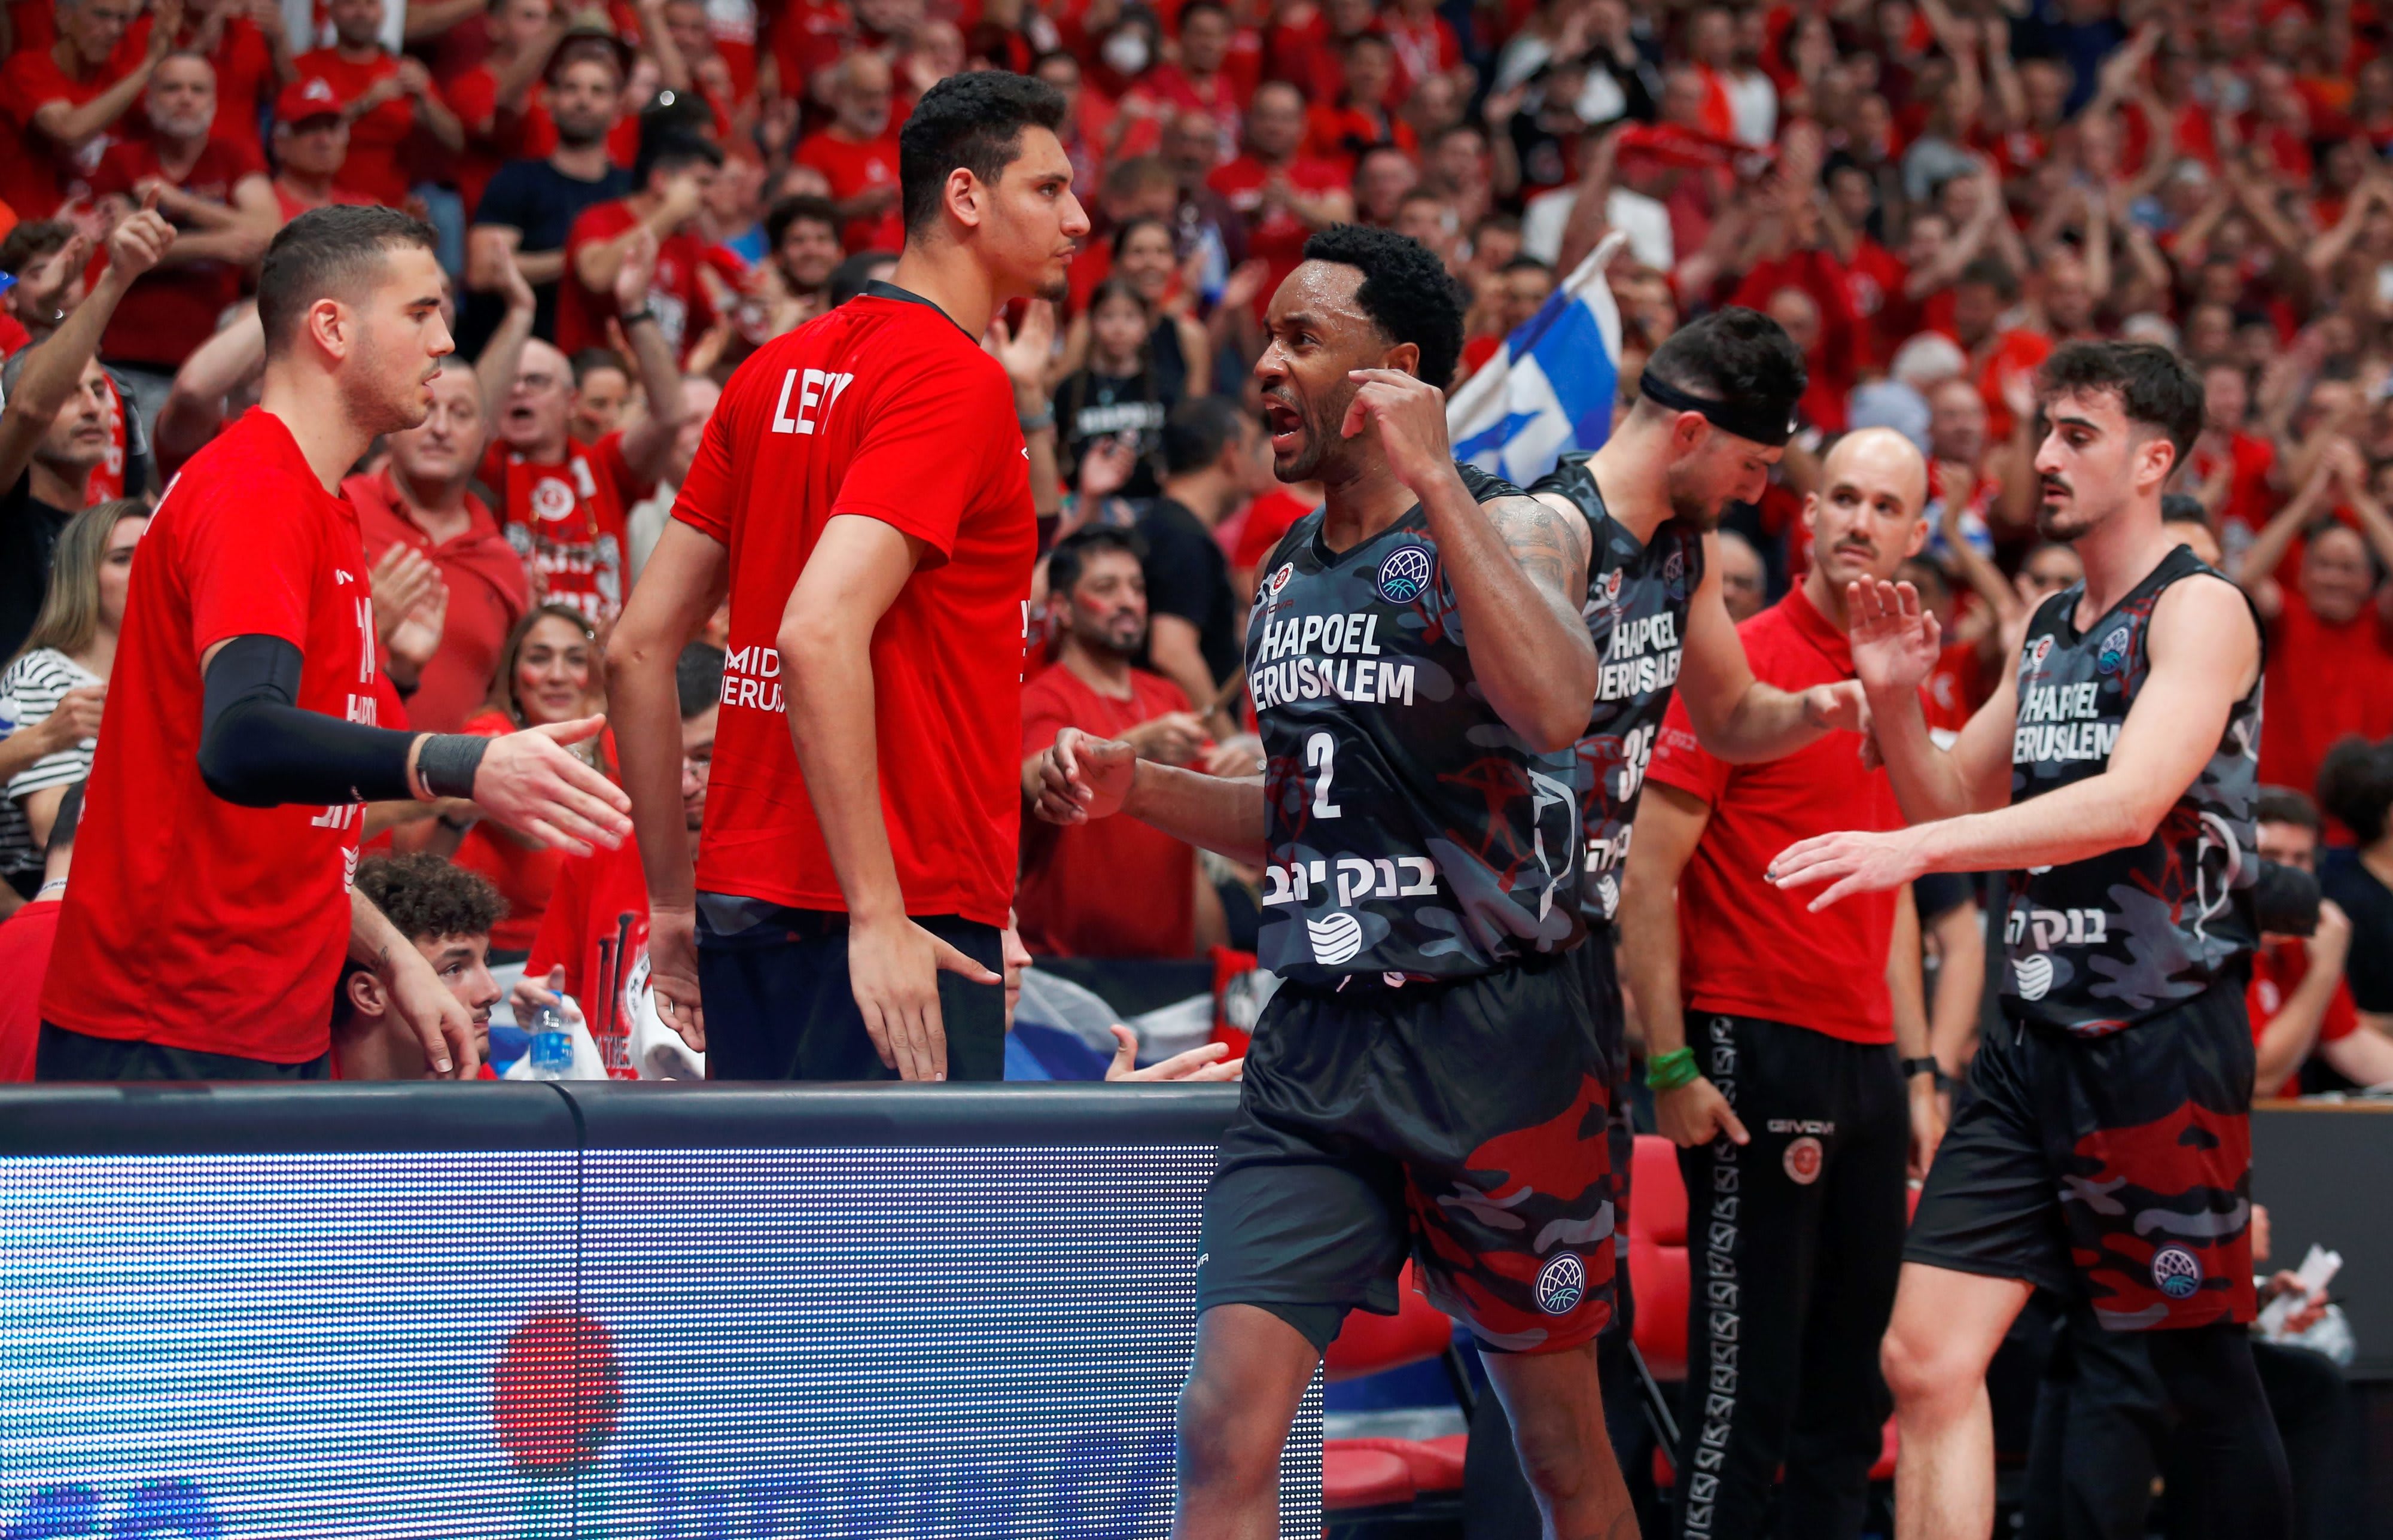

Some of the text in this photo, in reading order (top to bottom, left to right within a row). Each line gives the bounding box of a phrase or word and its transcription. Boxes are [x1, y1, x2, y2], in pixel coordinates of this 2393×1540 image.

[1262, 613, 1381, 664] HAPOEL
[1307, 732, 1341, 818] 2
[1618, 724, 1655, 802] 35
[1262, 857, 1438, 907] בנק יהב
[2030, 908, 2108, 951] בנק
